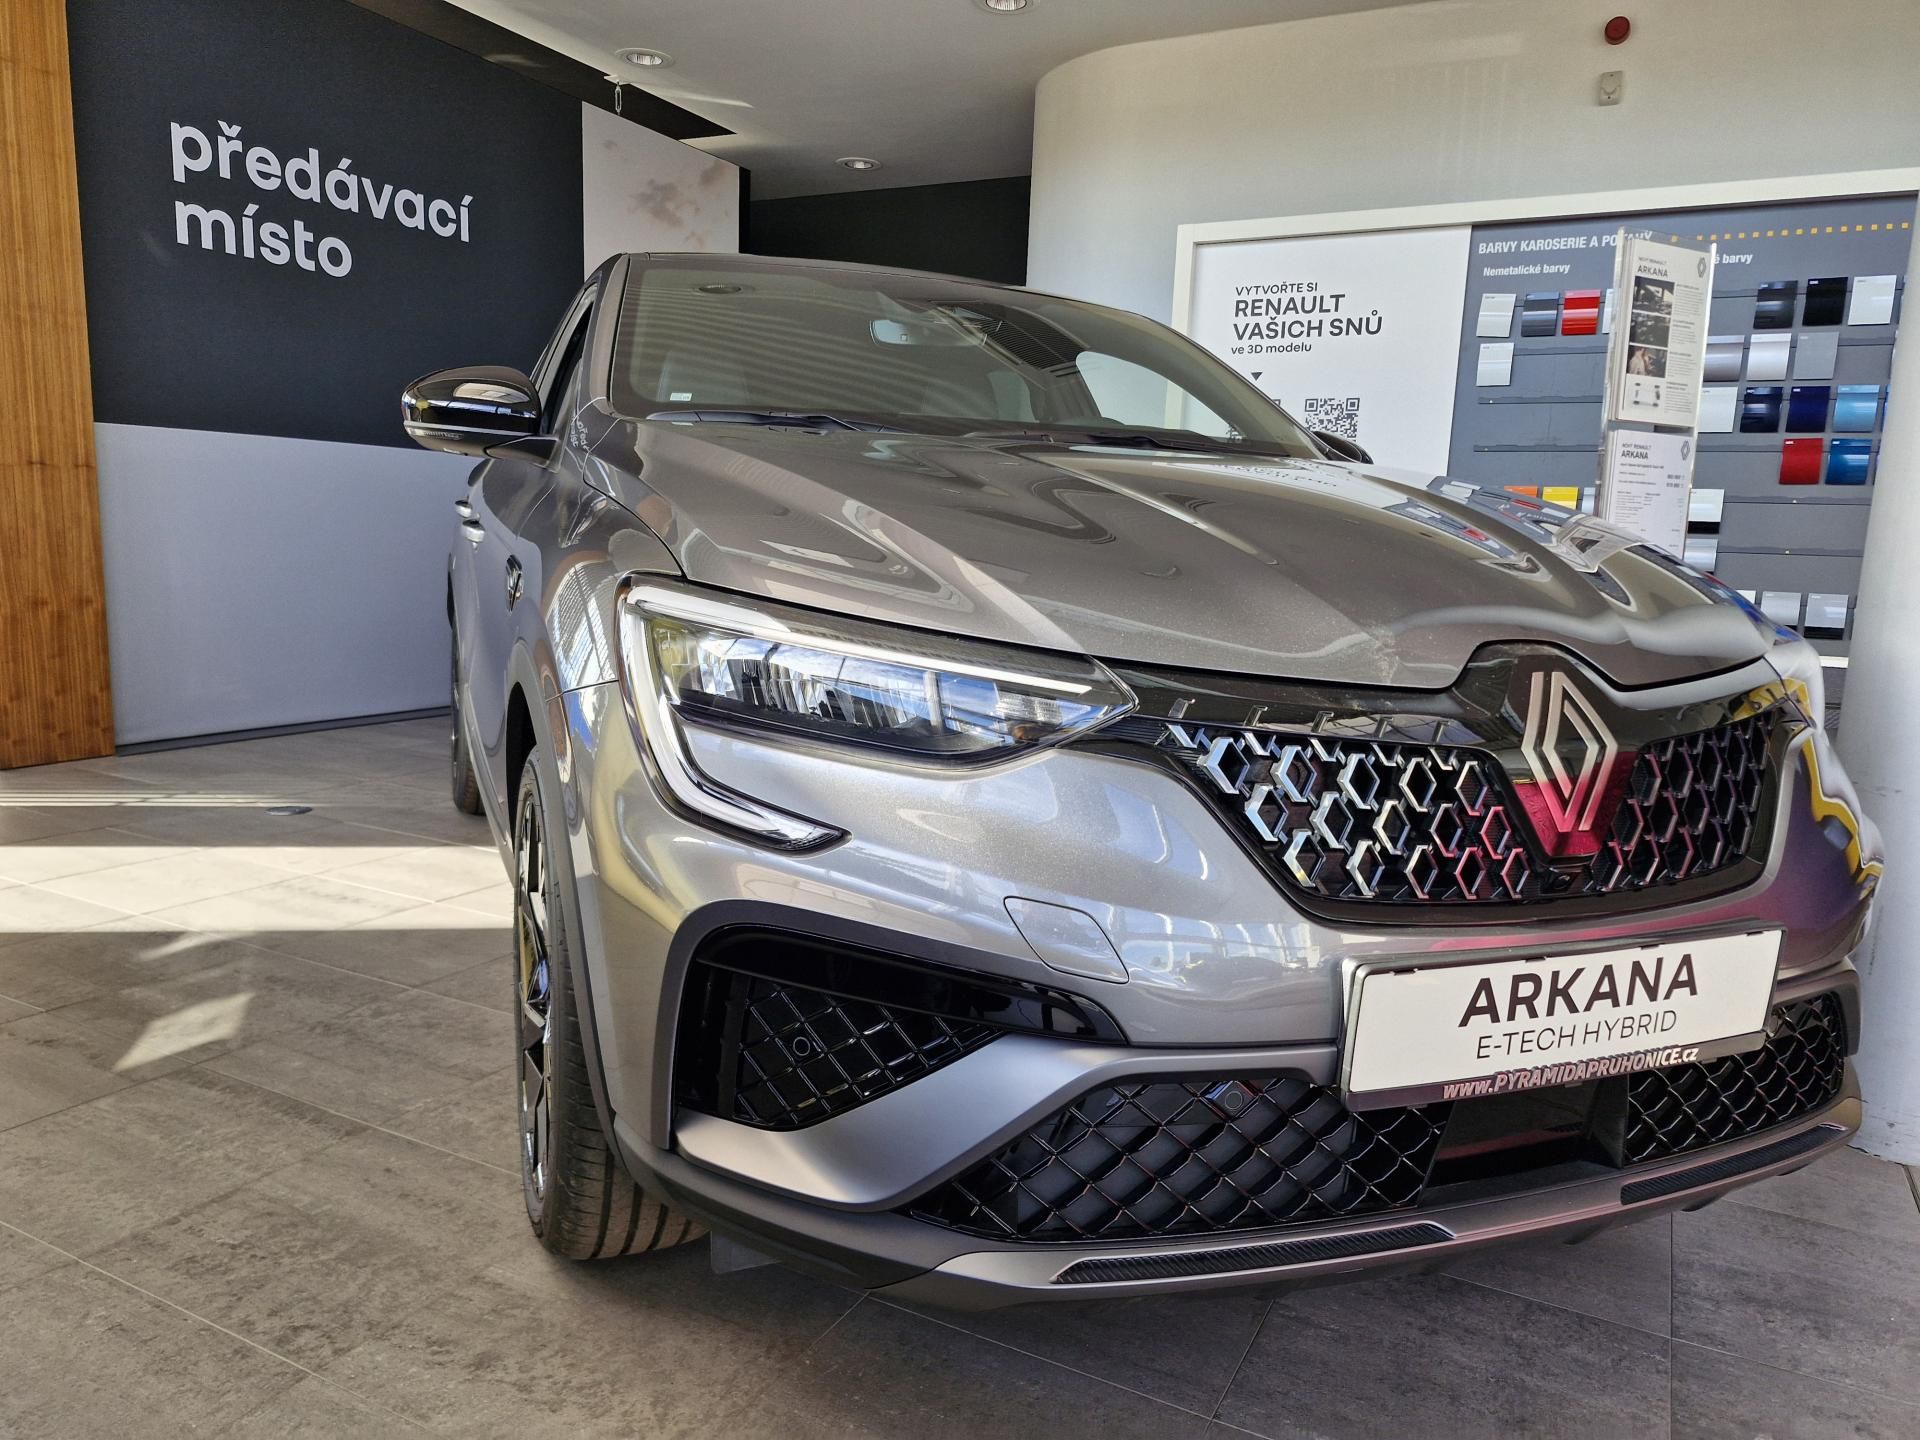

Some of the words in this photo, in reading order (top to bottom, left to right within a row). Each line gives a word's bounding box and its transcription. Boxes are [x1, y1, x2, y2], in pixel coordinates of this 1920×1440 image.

[171, 119, 474, 243] předávací
[174, 200, 353, 278] místo
[1478, 240, 1518, 254] BARVY
[1520, 236, 1587, 252] KAROSERIE
[1589, 235, 1599, 248] A
[1722, 253, 1754, 265] barvy
[1483, 263, 1542, 277] Nemetalické
[1543, 263, 1571, 274] barvy
[1637, 265, 1668, 277] ARKANA
[1235, 281, 1304, 296] VYTVOŘTE
[1306, 282, 1318, 293] SI
[1234, 294, 1346, 318] RENAULT
[1233, 316, 1323, 341] VAŠICH
[1329, 309, 1383, 337] SNŮ
[1231, 345, 1245, 355] ve
[1247, 344, 1263, 354] 3D
[1265, 342, 1312, 354] modelu
[1621, 450, 1649, 460] ARKANA
[1458, 953, 1698, 1027] ARKANA
[1476, 1024, 1576, 1060] E-TECH
[1582, 1010, 1677, 1045] HYBRID
